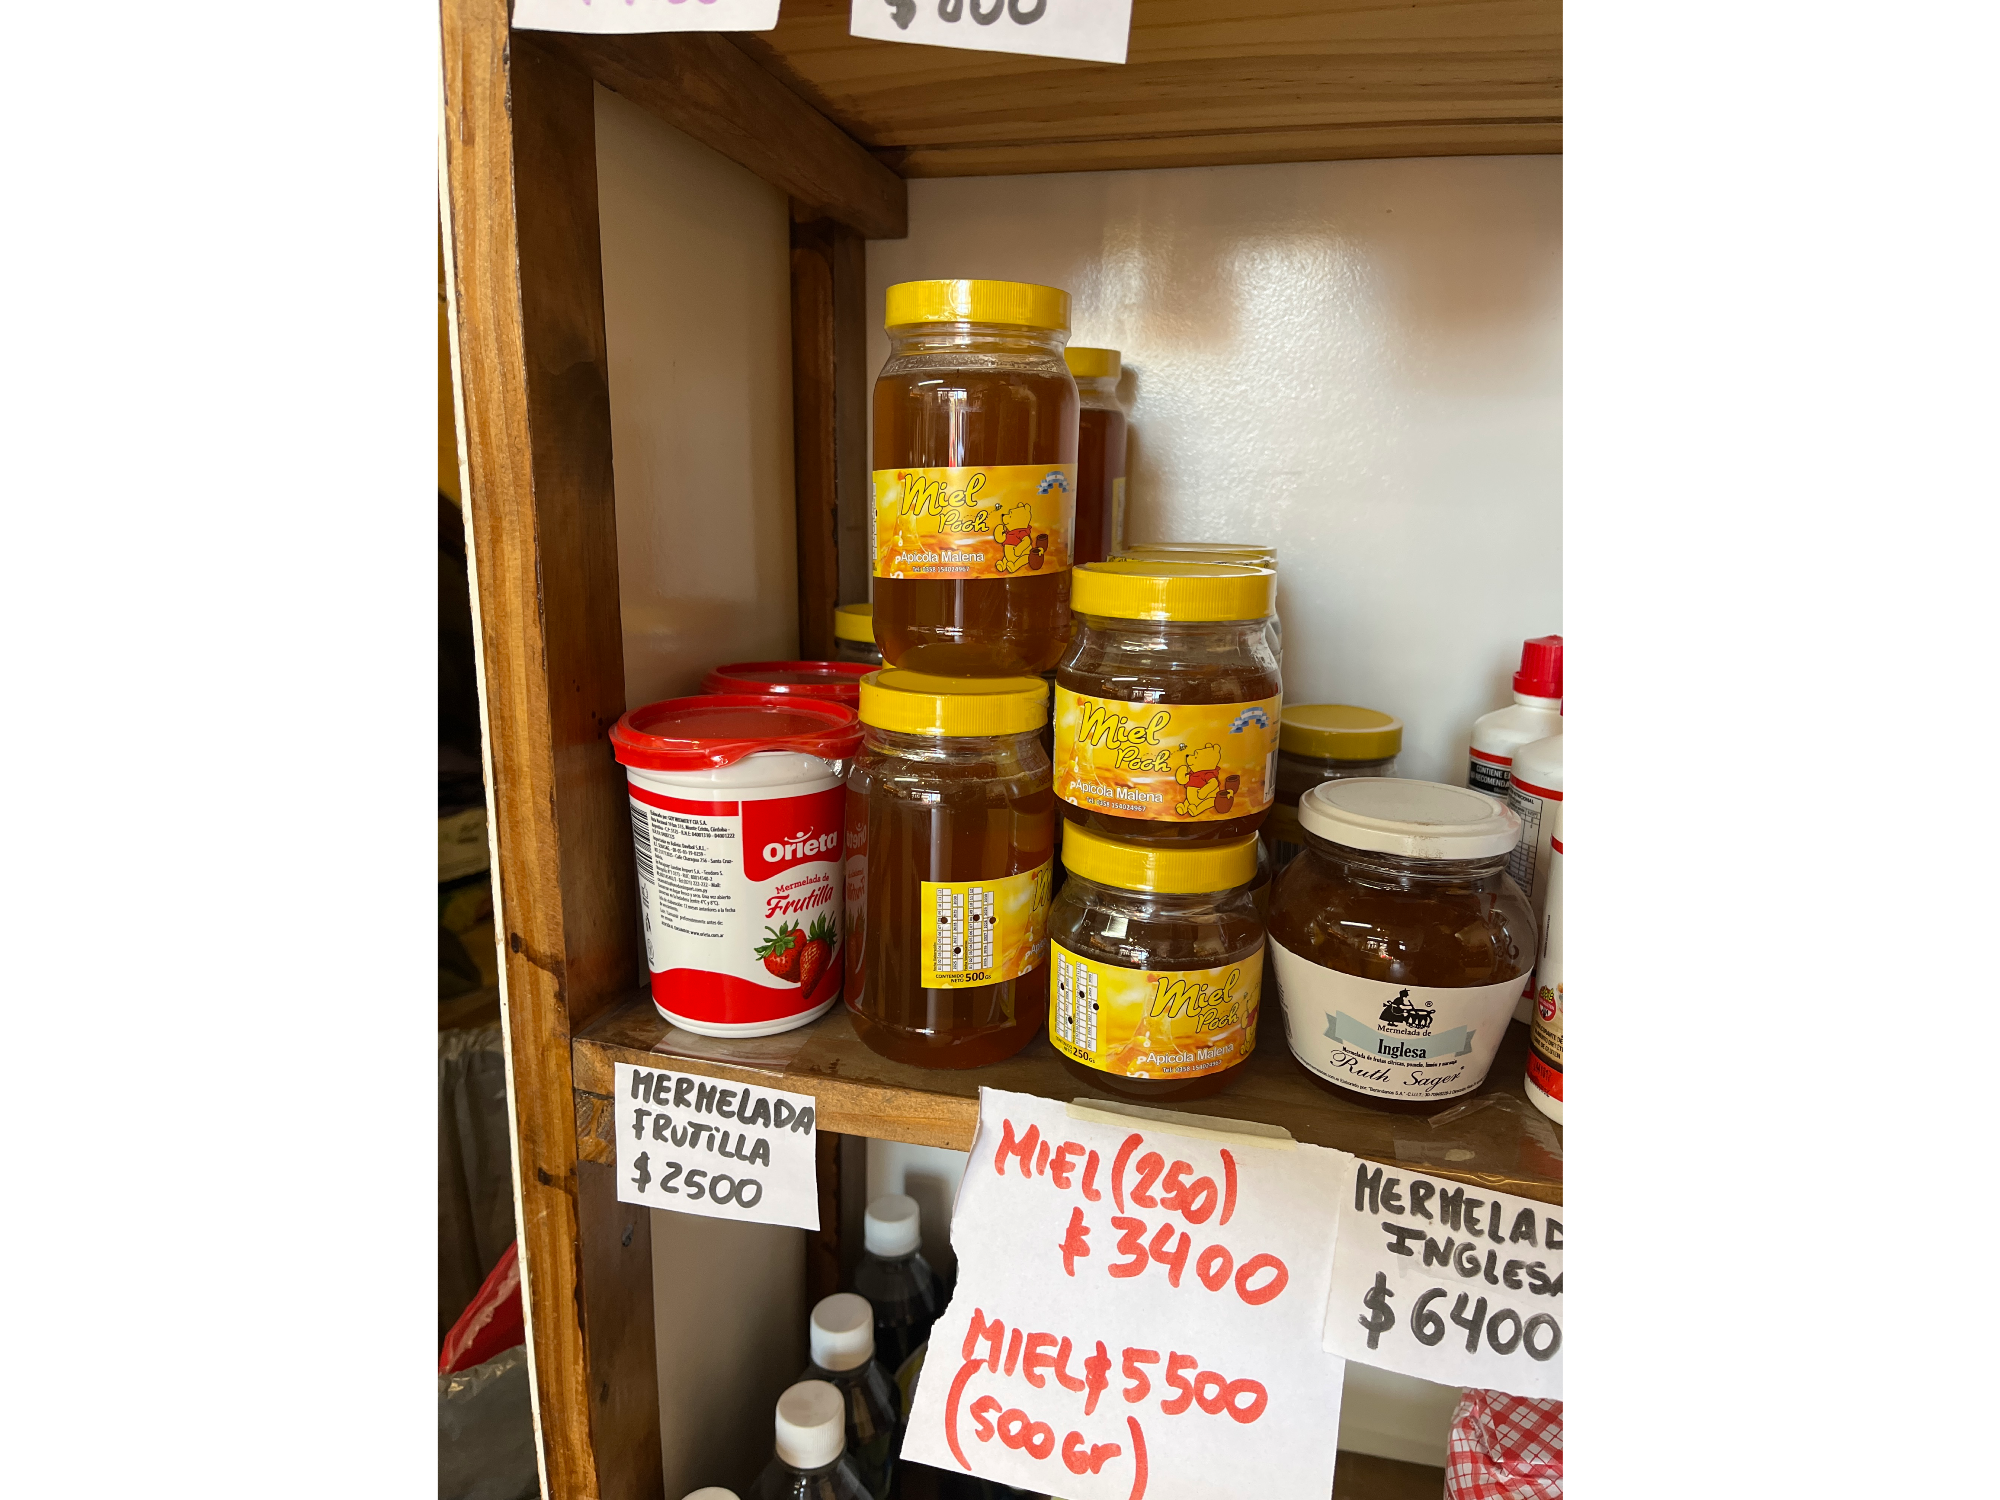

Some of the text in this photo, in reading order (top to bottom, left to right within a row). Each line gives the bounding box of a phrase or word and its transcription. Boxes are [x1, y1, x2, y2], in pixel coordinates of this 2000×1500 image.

[901, 473, 986, 516] Miel
[938, 510, 989, 533] Pooh
[941, 551, 985, 563] Malena
[1078, 701, 1171, 750] Miel
[1115, 746, 1171, 772] Pooh
[1476, 764, 1503, 779] CONTIENE
[1116, 787, 1163, 803] Malena
[1111, 802, 1147, 812] 154024967
[822, 872, 830, 882] de
[765, 884, 834, 919] Frutilla
[965, 972, 985, 982] 500
[1150, 968, 1241, 1018] Miel
[1195, 1002, 1240, 1034] Pooh
[1377, 1023, 1432, 1037] Mermelada de
[1073, 1046, 1089, 1062] 250
[1196, 1042, 1234, 1060] Malena
[1377, 1038, 1427, 1059] Inglesa
[1330, 1049, 1392, 1084] Ruth
[1403, 1069, 1462, 1093] Sager
[631, 1068, 815, 1135] MERMELADA
